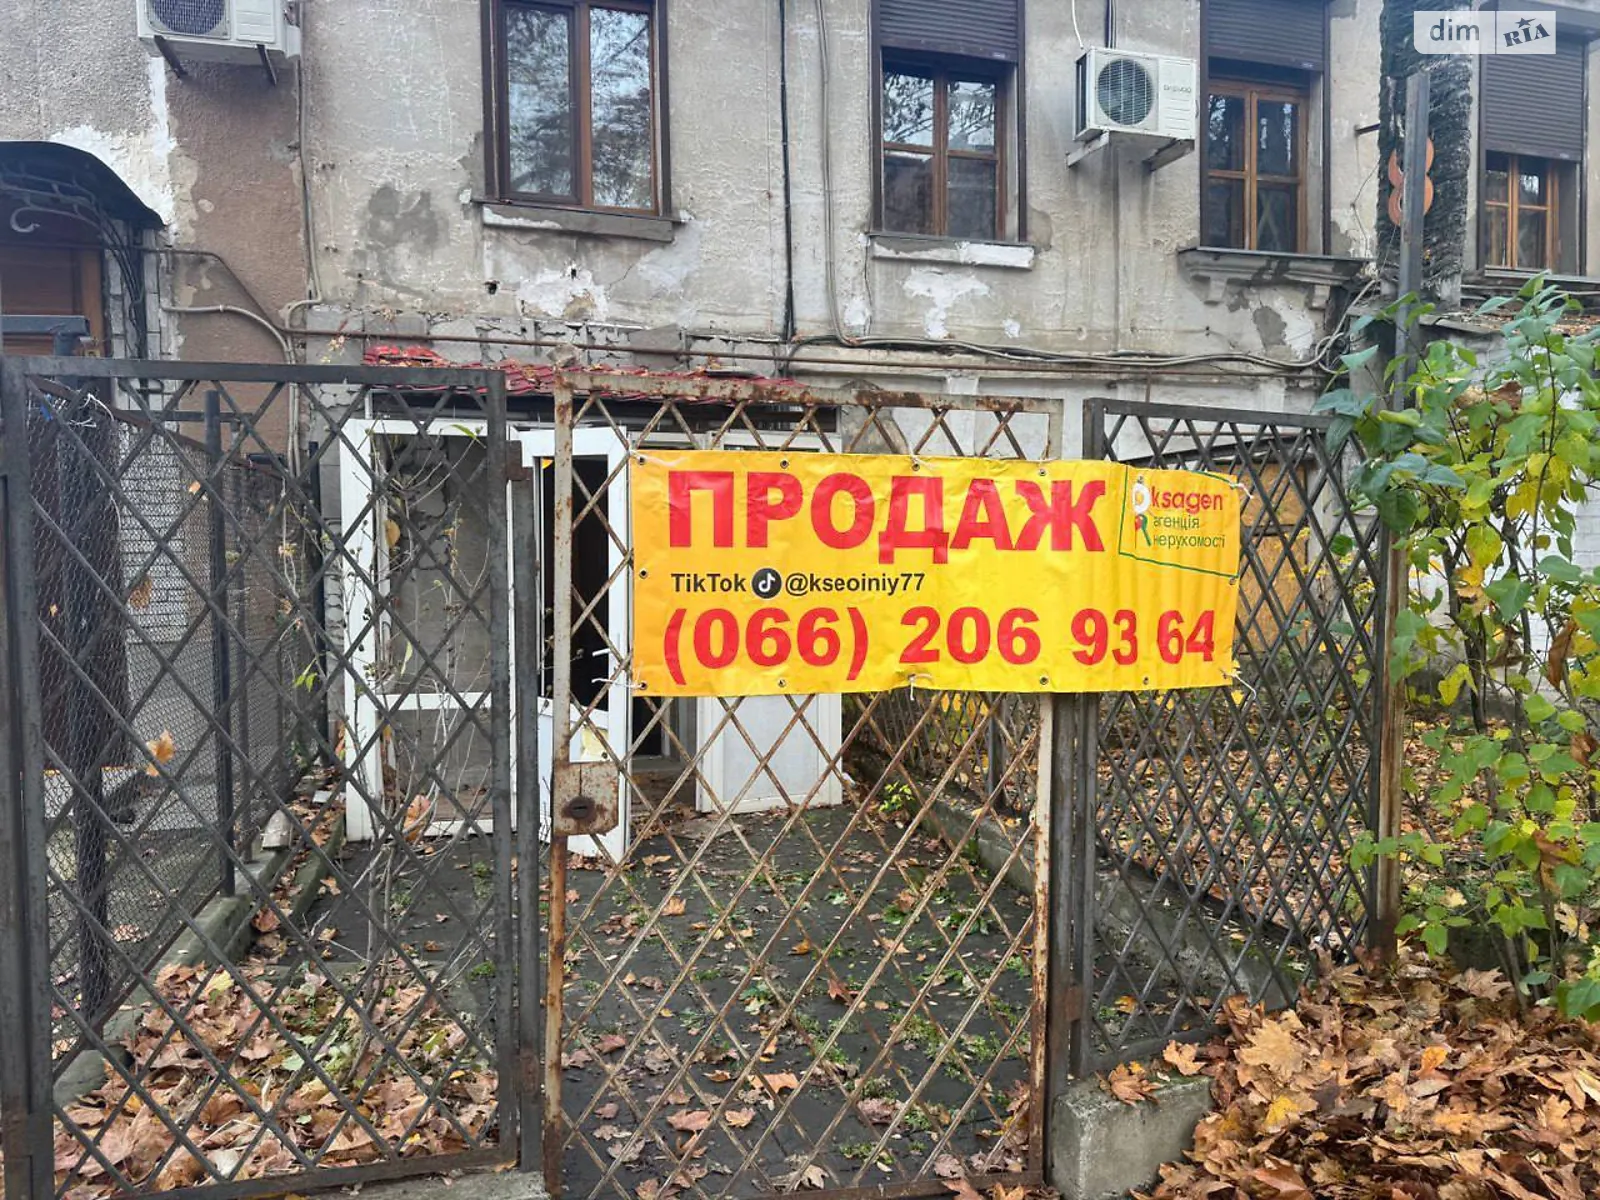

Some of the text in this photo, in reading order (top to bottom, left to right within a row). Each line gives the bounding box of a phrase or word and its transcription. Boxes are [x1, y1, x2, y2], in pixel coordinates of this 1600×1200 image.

[668, 470, 1106, 564] ПРОДАЖ
[1153, 515, 1200, 530] агенція
[671, 573, 926, 596] TikTok @kseoiniy77
[663, 605, 1215, 686] (066) 206 93 64
